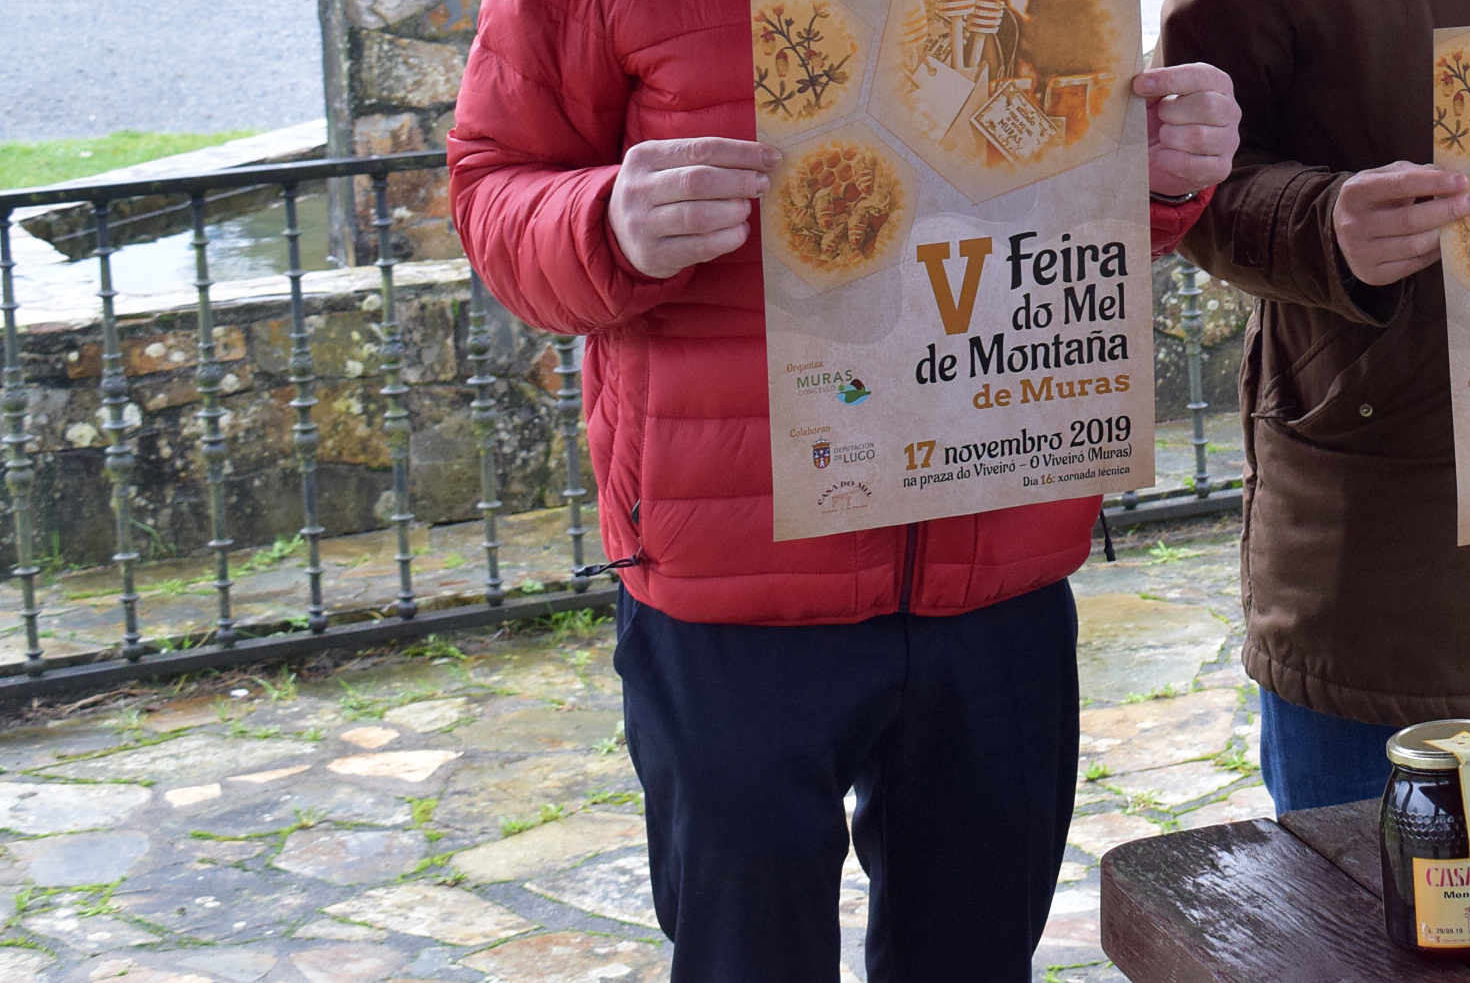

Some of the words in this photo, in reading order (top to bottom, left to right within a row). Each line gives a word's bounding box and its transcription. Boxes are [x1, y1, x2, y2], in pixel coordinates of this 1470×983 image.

[917, 237, 992, 336] V
[1006, 231, 1128, 290] Feira
[1012, 293, 1052, 331] do
[1063, 282, 1126, 325] Mel
[796, 369, 853, 390] MURAS
[915, 343, 957, 385] de
[969, 330, 1129, 378] Montaña
[972, 383, 1012, 410] de
[1019, 374, 1130, 405] Muras
[843, 449, 876, 464] LUGO
[903, 476, 917, 488] na
[920, 471, 954, 490] praza
[956, 466, 971, 480] do
[1030, 455, 1040, 469] O
[1088, 442, 1132, 462] (Muras)
[904, 440, 937, 471] 17
[944, 428, 1063, 466] novembro
[1069, 415, 1131, 449] 2019
